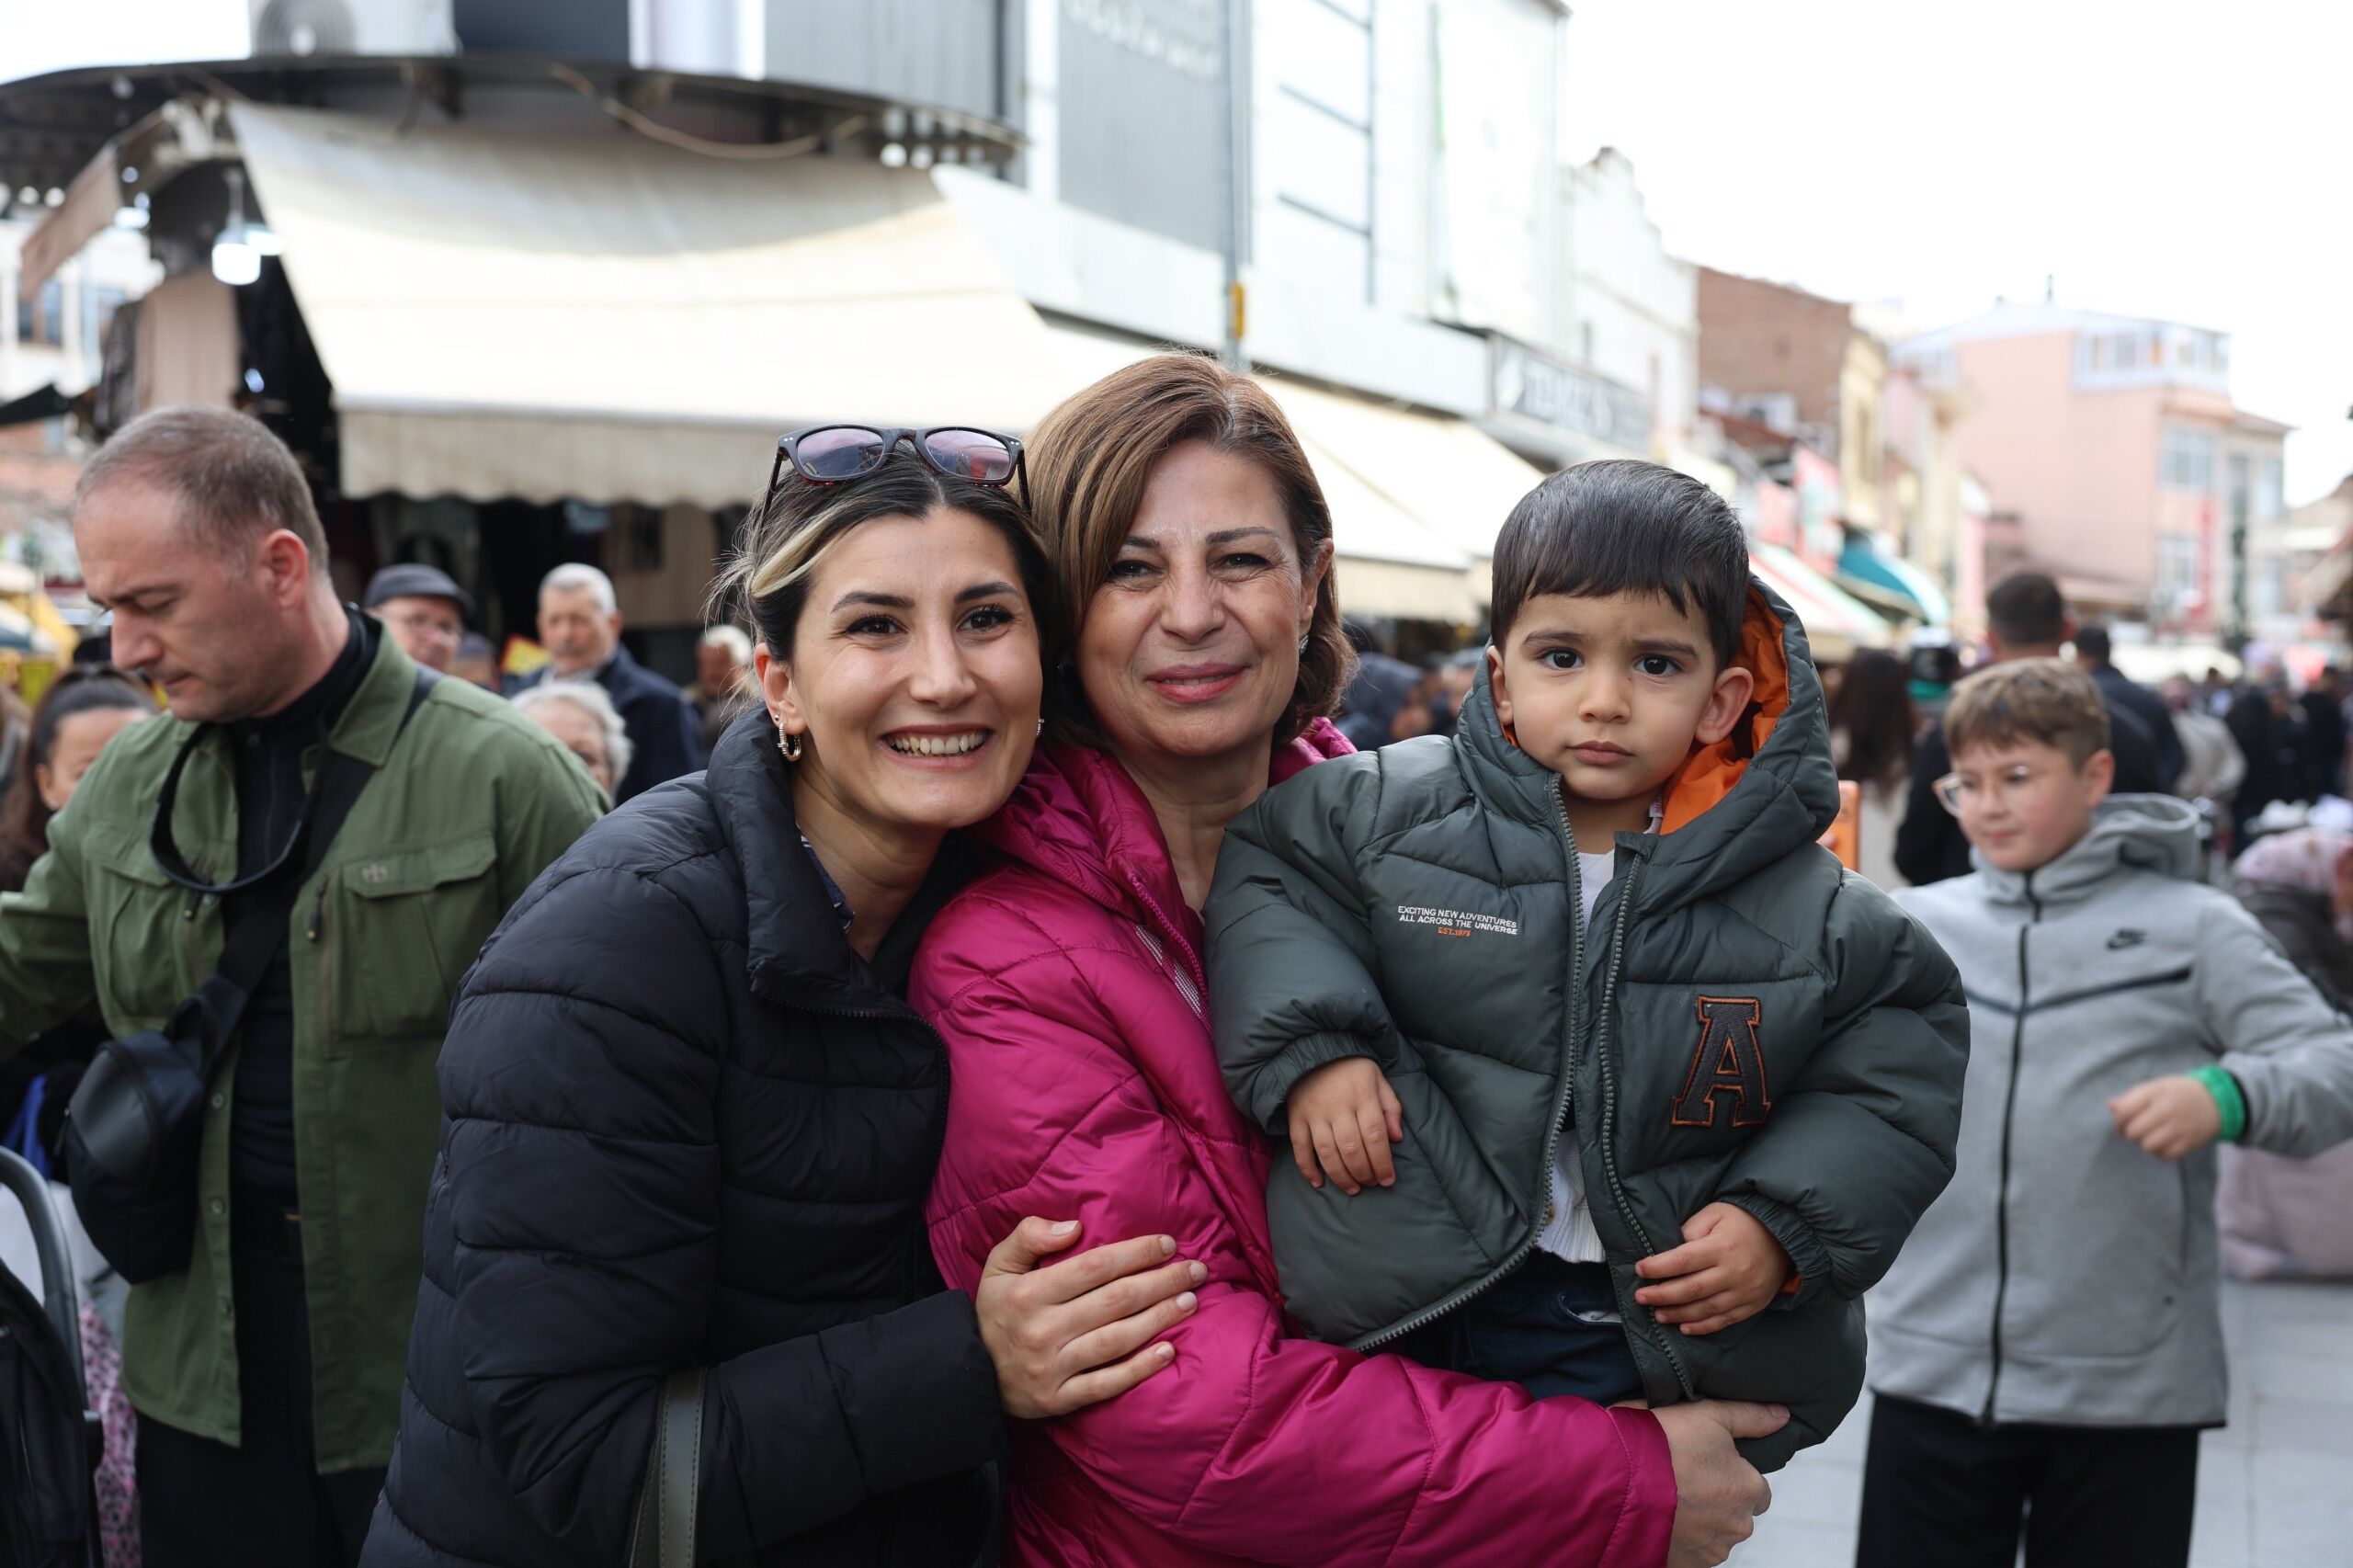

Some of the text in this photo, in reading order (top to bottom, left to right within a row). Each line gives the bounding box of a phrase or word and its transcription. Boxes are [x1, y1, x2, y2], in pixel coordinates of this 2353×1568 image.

[1398, 905, 1517, 927] EXCITING NEW ADVENTURES
[1399, 914, 1518, 935] ALL ACROSS THE UNIVERSE
[1671, 995, 1771, 1127] A
